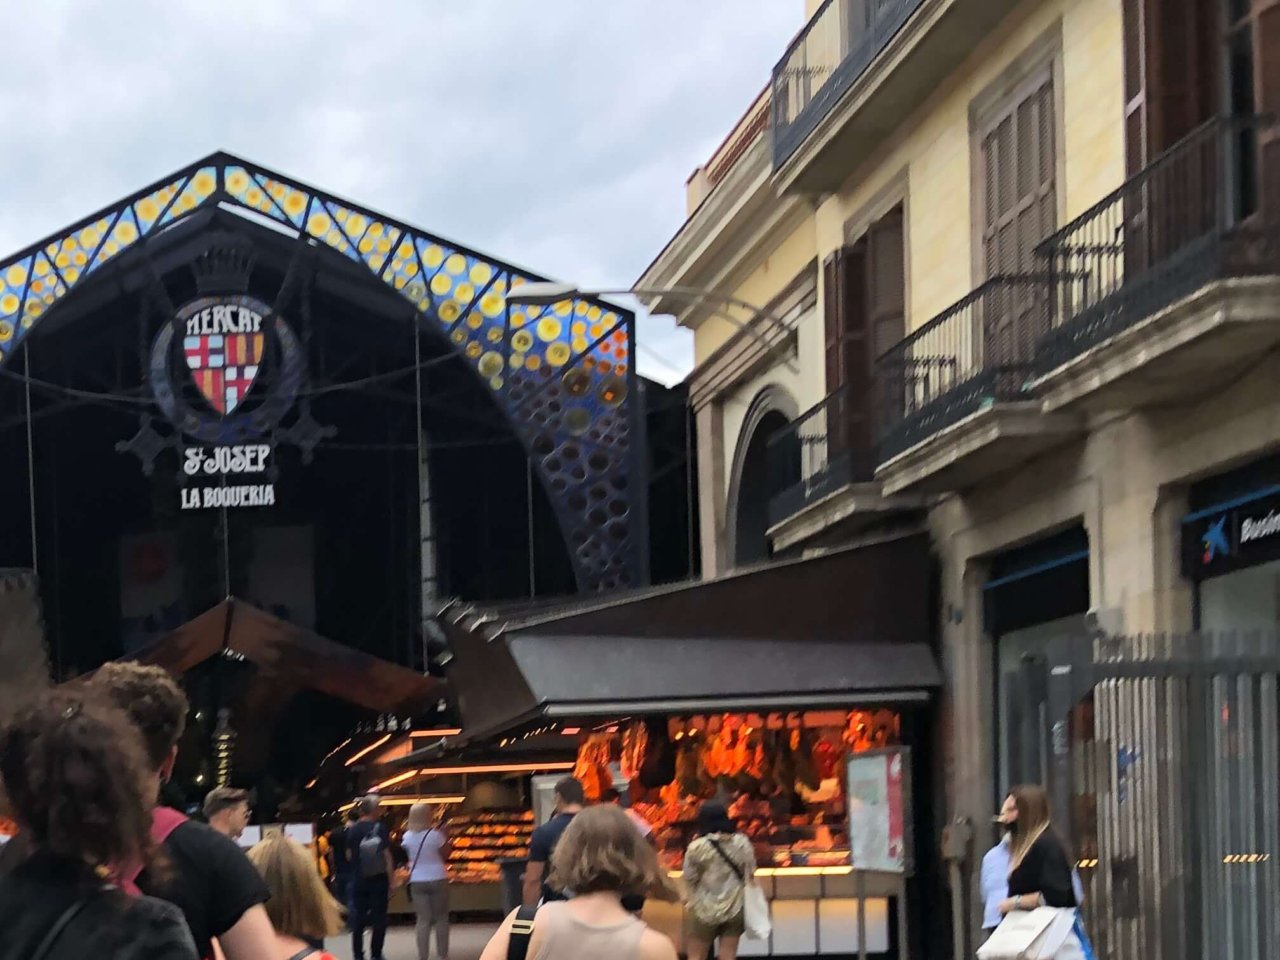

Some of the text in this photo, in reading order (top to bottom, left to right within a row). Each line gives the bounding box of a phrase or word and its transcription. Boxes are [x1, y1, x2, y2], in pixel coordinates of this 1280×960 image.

[186, 304, 263, 336] MERCAT
[181, 484, 275, 509] LA BOQUERIA
